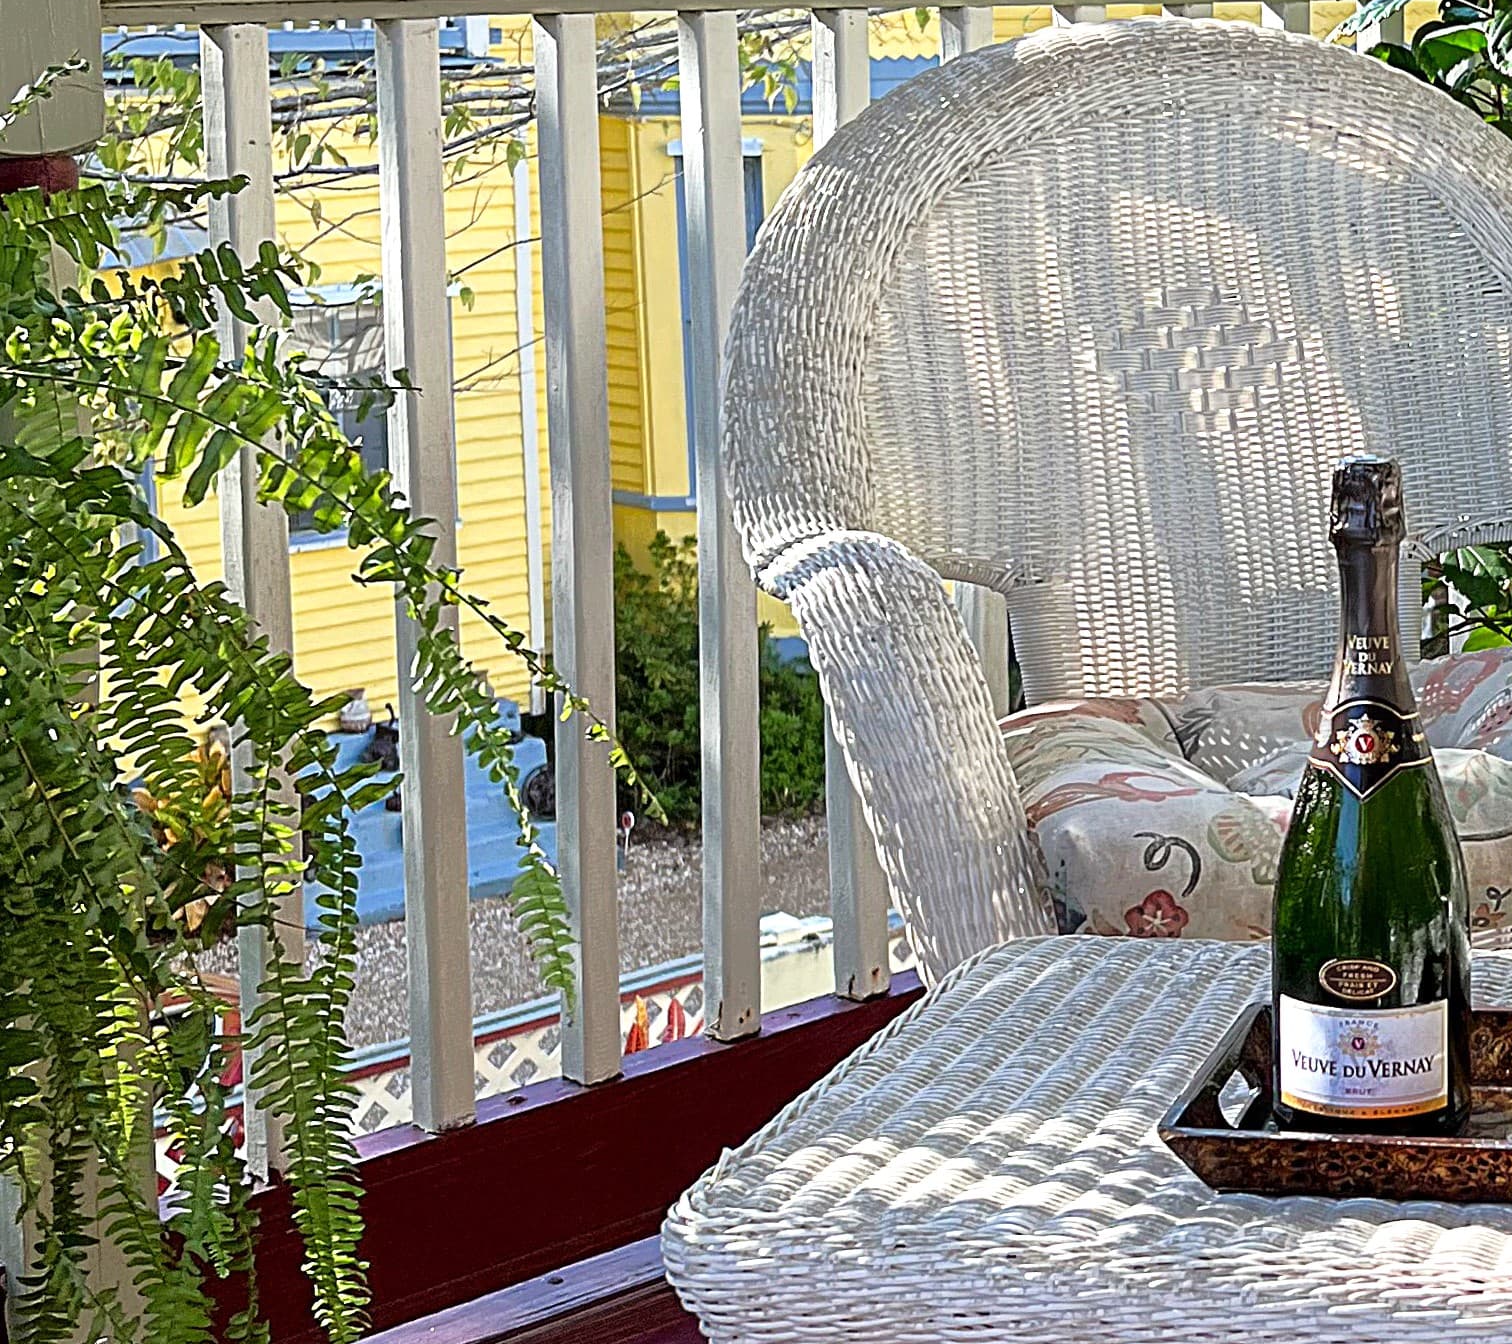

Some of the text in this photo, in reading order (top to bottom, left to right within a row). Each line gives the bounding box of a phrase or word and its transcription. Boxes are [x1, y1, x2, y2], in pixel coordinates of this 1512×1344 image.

[1347, 635, 1389, 650] VEUVE
[1358, 652, 1376, 663] DU
[1343, 660, 1393, 675] VERNAY
[1358, 736, 1373, 752] V
[1338, 1019, 1379, 1030] FRANCE
[1292, 1049, 1435, 1078] VEUVE DU VERNAY
[1344, 1087, 1373, 1096] BRUT
